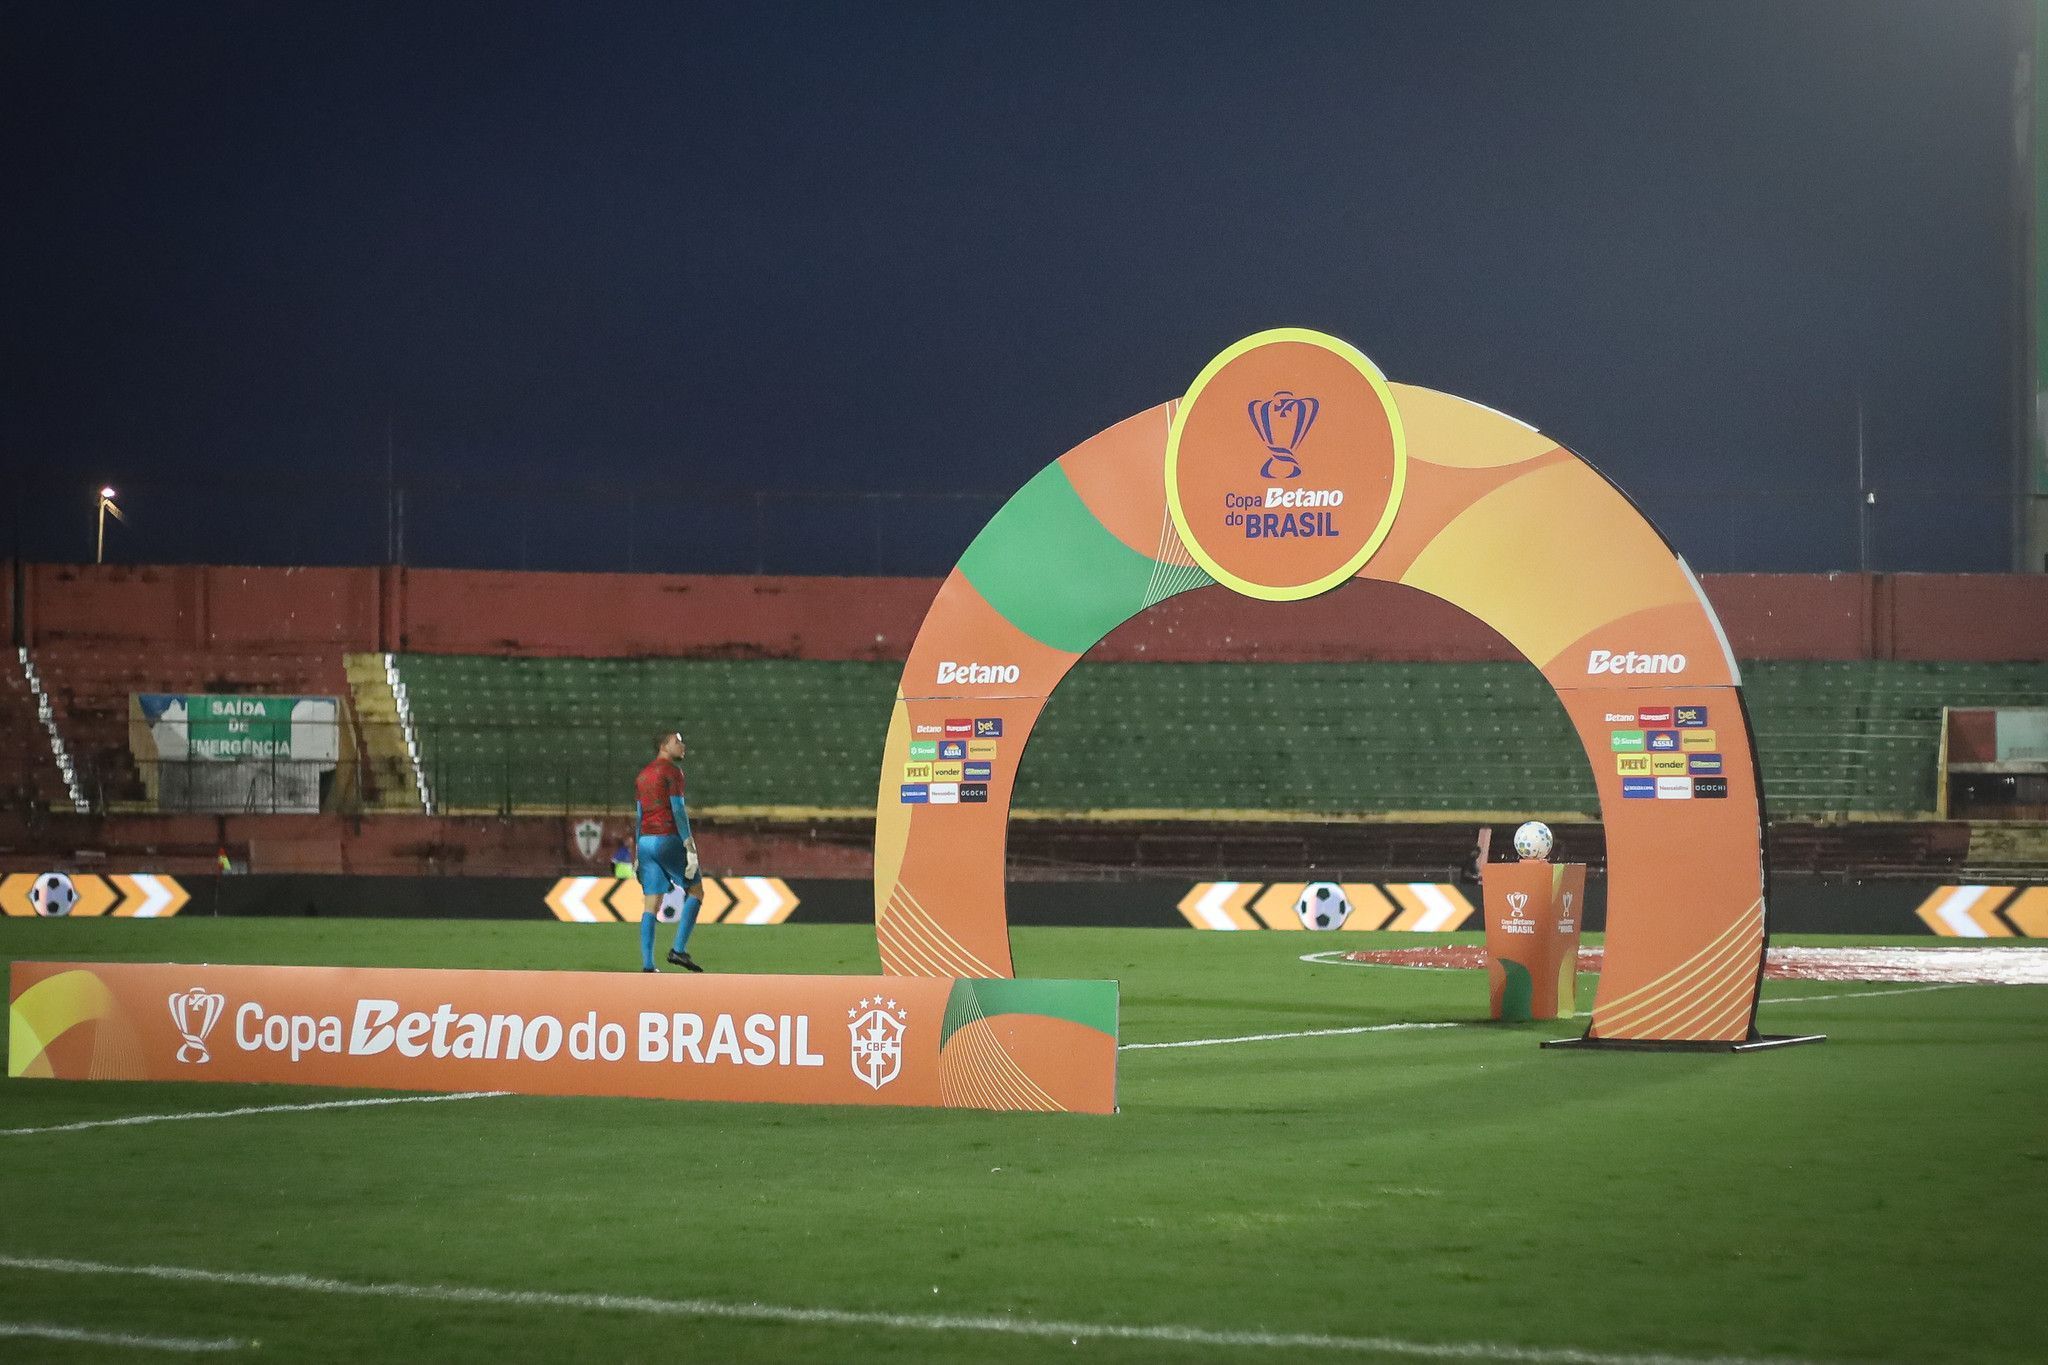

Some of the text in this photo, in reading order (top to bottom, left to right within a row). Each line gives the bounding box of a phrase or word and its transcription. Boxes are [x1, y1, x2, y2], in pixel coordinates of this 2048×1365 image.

[1225, 487, 1344, 510] Copa Betano
[1225, 511, 1339, 538] do BRASIL
[1587, 650, 1686, 674] Betano
[936, 661, 1020, 684] Betano
[212, 699, 266, 716] SAÍDA
[1604, 713, 1635, 722] Betano
[228, 719, 249, 733] DE
[916, 724, 942, 734] Betano
[1654, 760, 1684, 769] vonder
[935, 768, 960, 776] vonder
[1507, 925, 1535, 934] BRASIL
[235, 999, 824, 1067] Copa Betano do BRASIL
[866, 1042, 887, 1051] CBF
